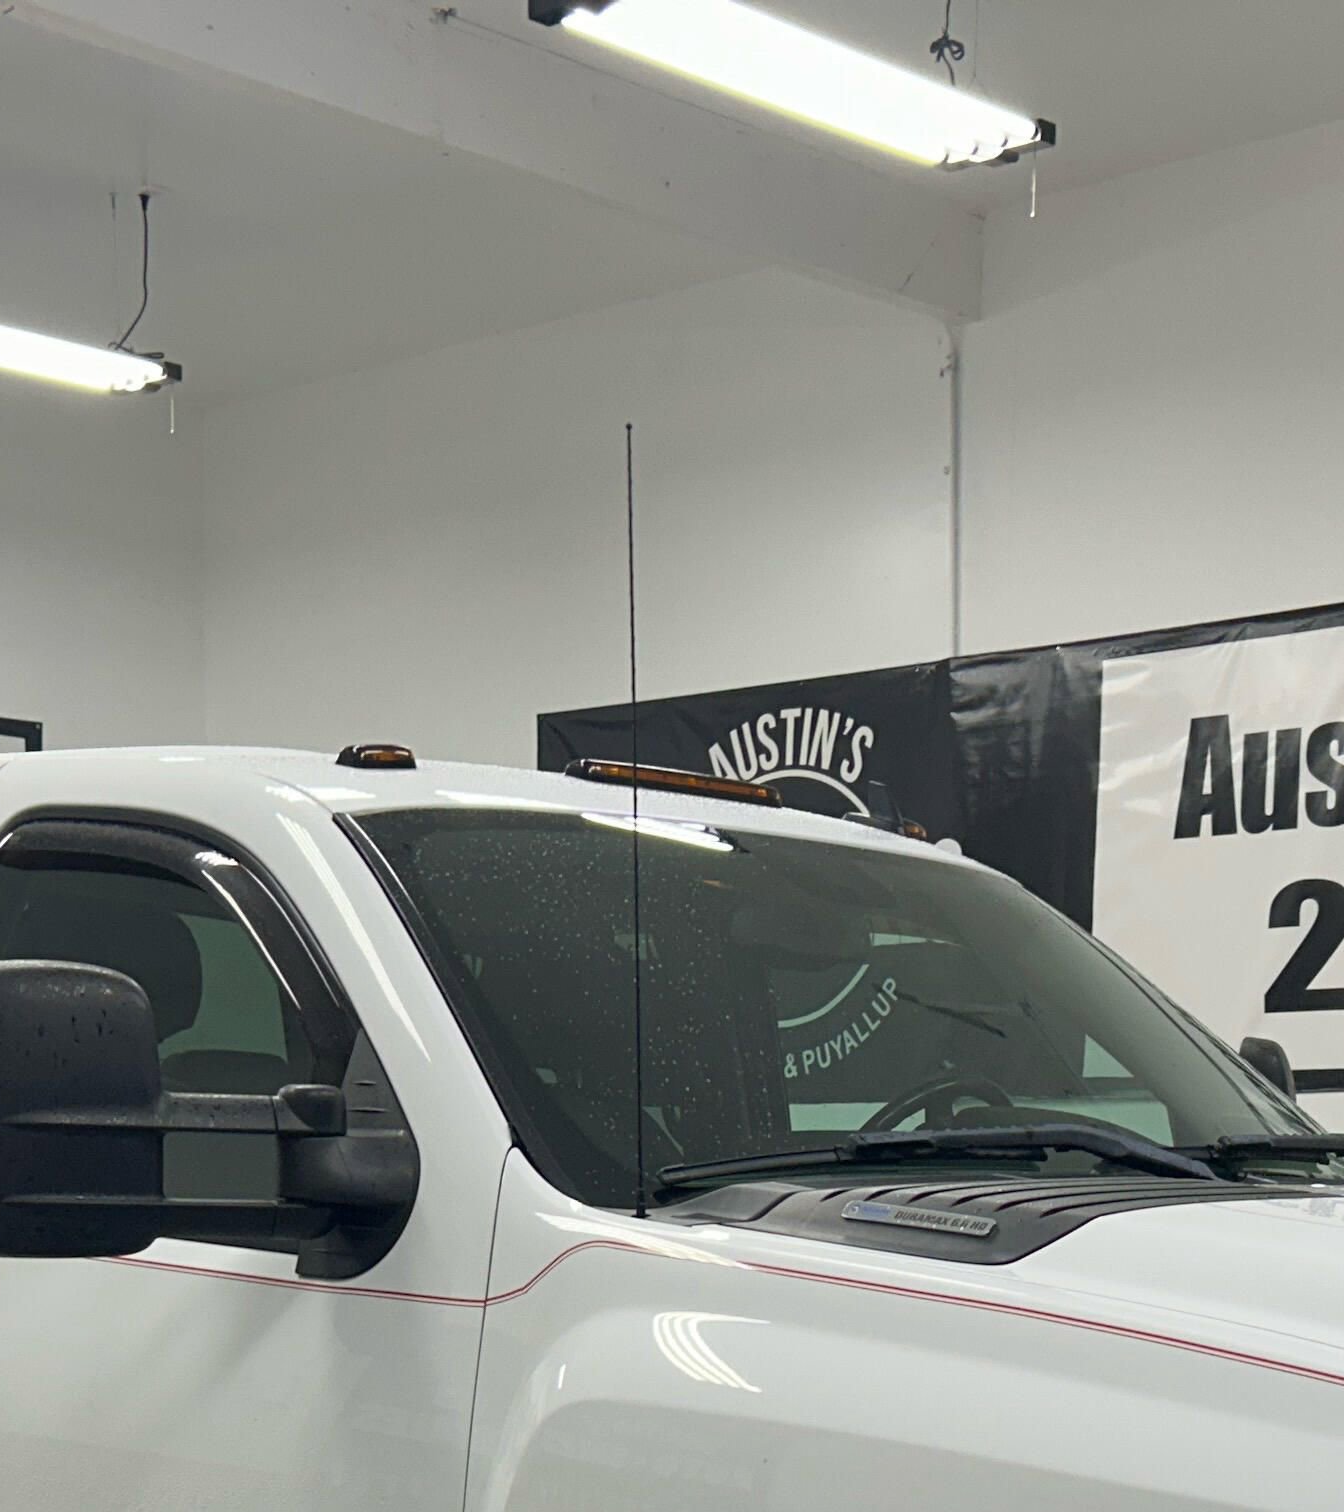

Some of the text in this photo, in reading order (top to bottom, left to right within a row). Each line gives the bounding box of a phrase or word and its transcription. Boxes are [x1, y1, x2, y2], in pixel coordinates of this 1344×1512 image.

[708, 707, 875, 783] AUSTIN'S
[783, 977, 899, 1078] & PUYALLUP
